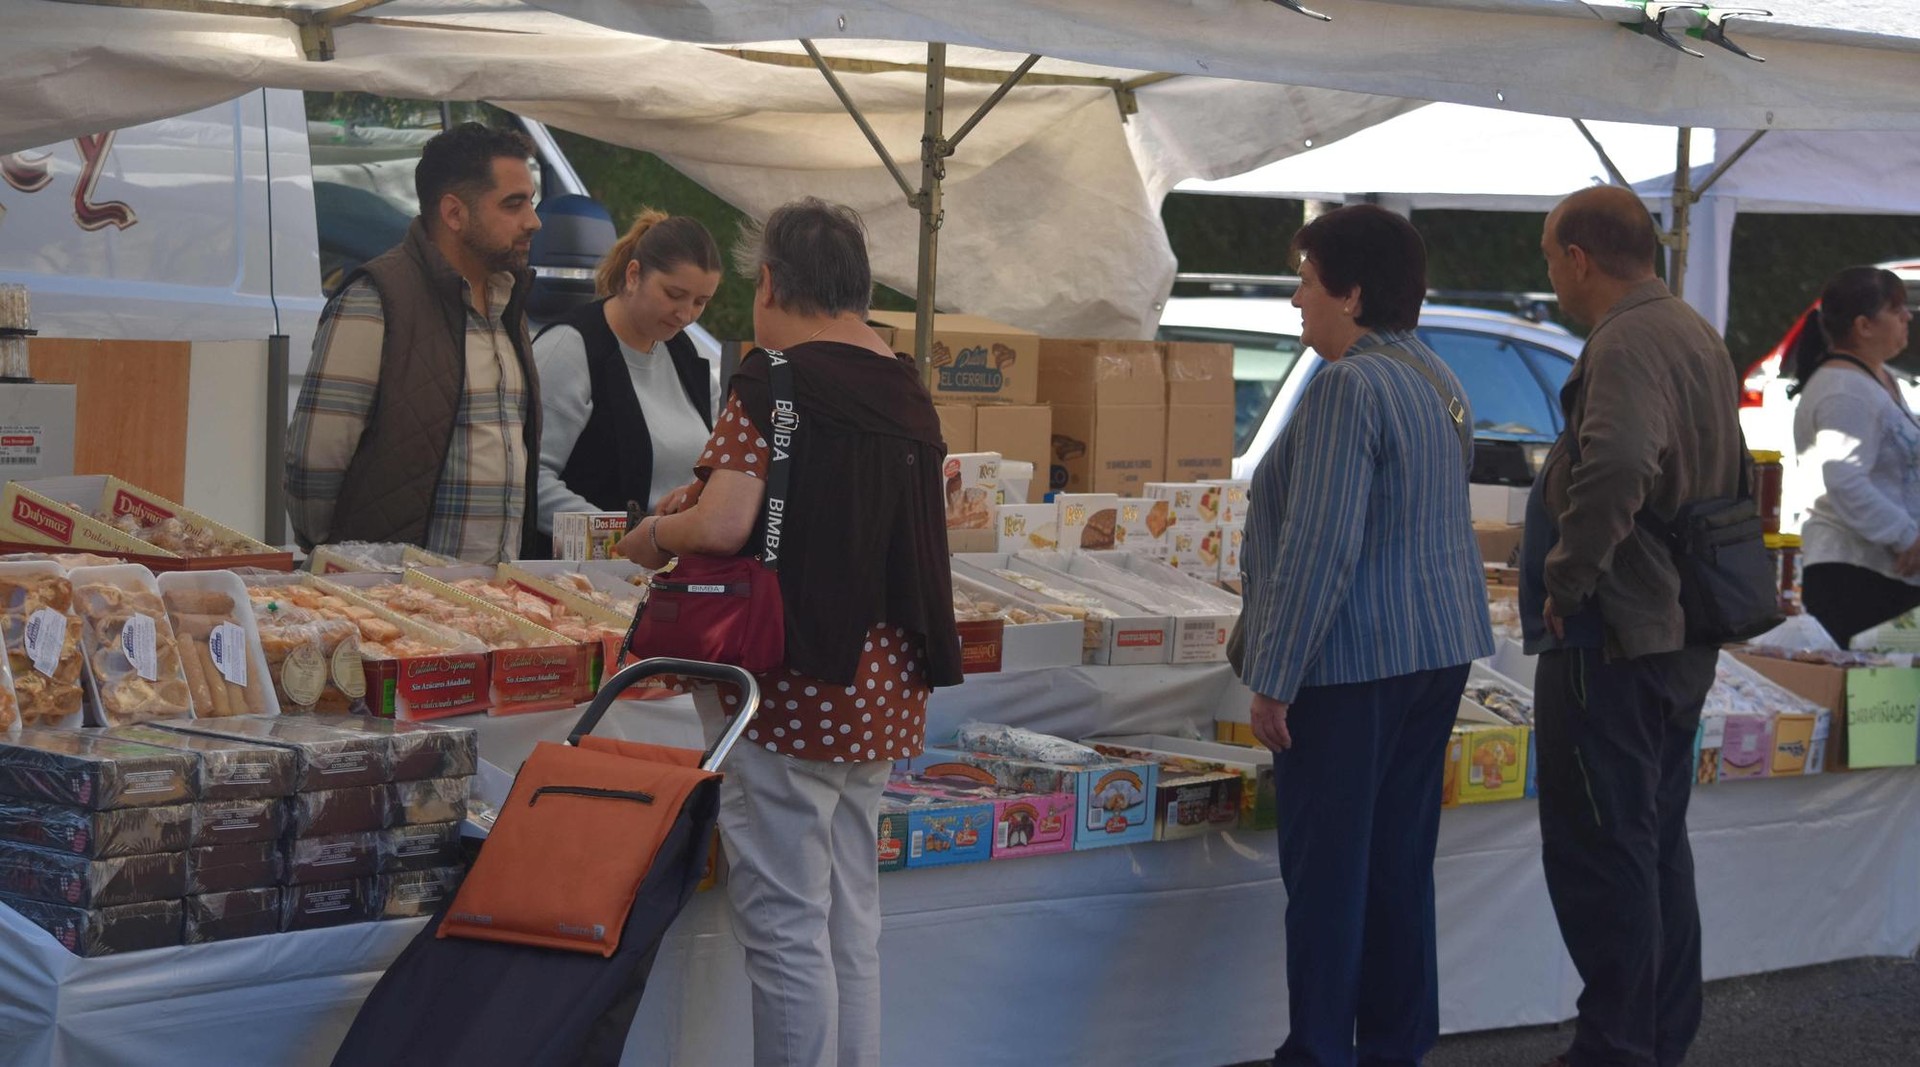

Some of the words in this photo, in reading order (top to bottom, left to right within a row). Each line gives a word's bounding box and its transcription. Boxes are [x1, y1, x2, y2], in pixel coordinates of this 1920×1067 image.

[941, 371, 953, 385] EL
[955, 371, 1002, 388] CERRILLO
[772, 399, 793, 462] BIMBA
[978, 463, 996, 479] Rey
[18, 499, 69, 535] Dulymaz
[119, 493, 163, 525] Dulyma
[1065, 504, 1087, 526] Rey
[595, 518, 609, 530] Dos
[764, 497, 785, 562] BIMBA
[1004, 514, 1027, 537] Rey
[691, 585, 719, 593] BIMBA
[411, 682, 422, 692] Sin
